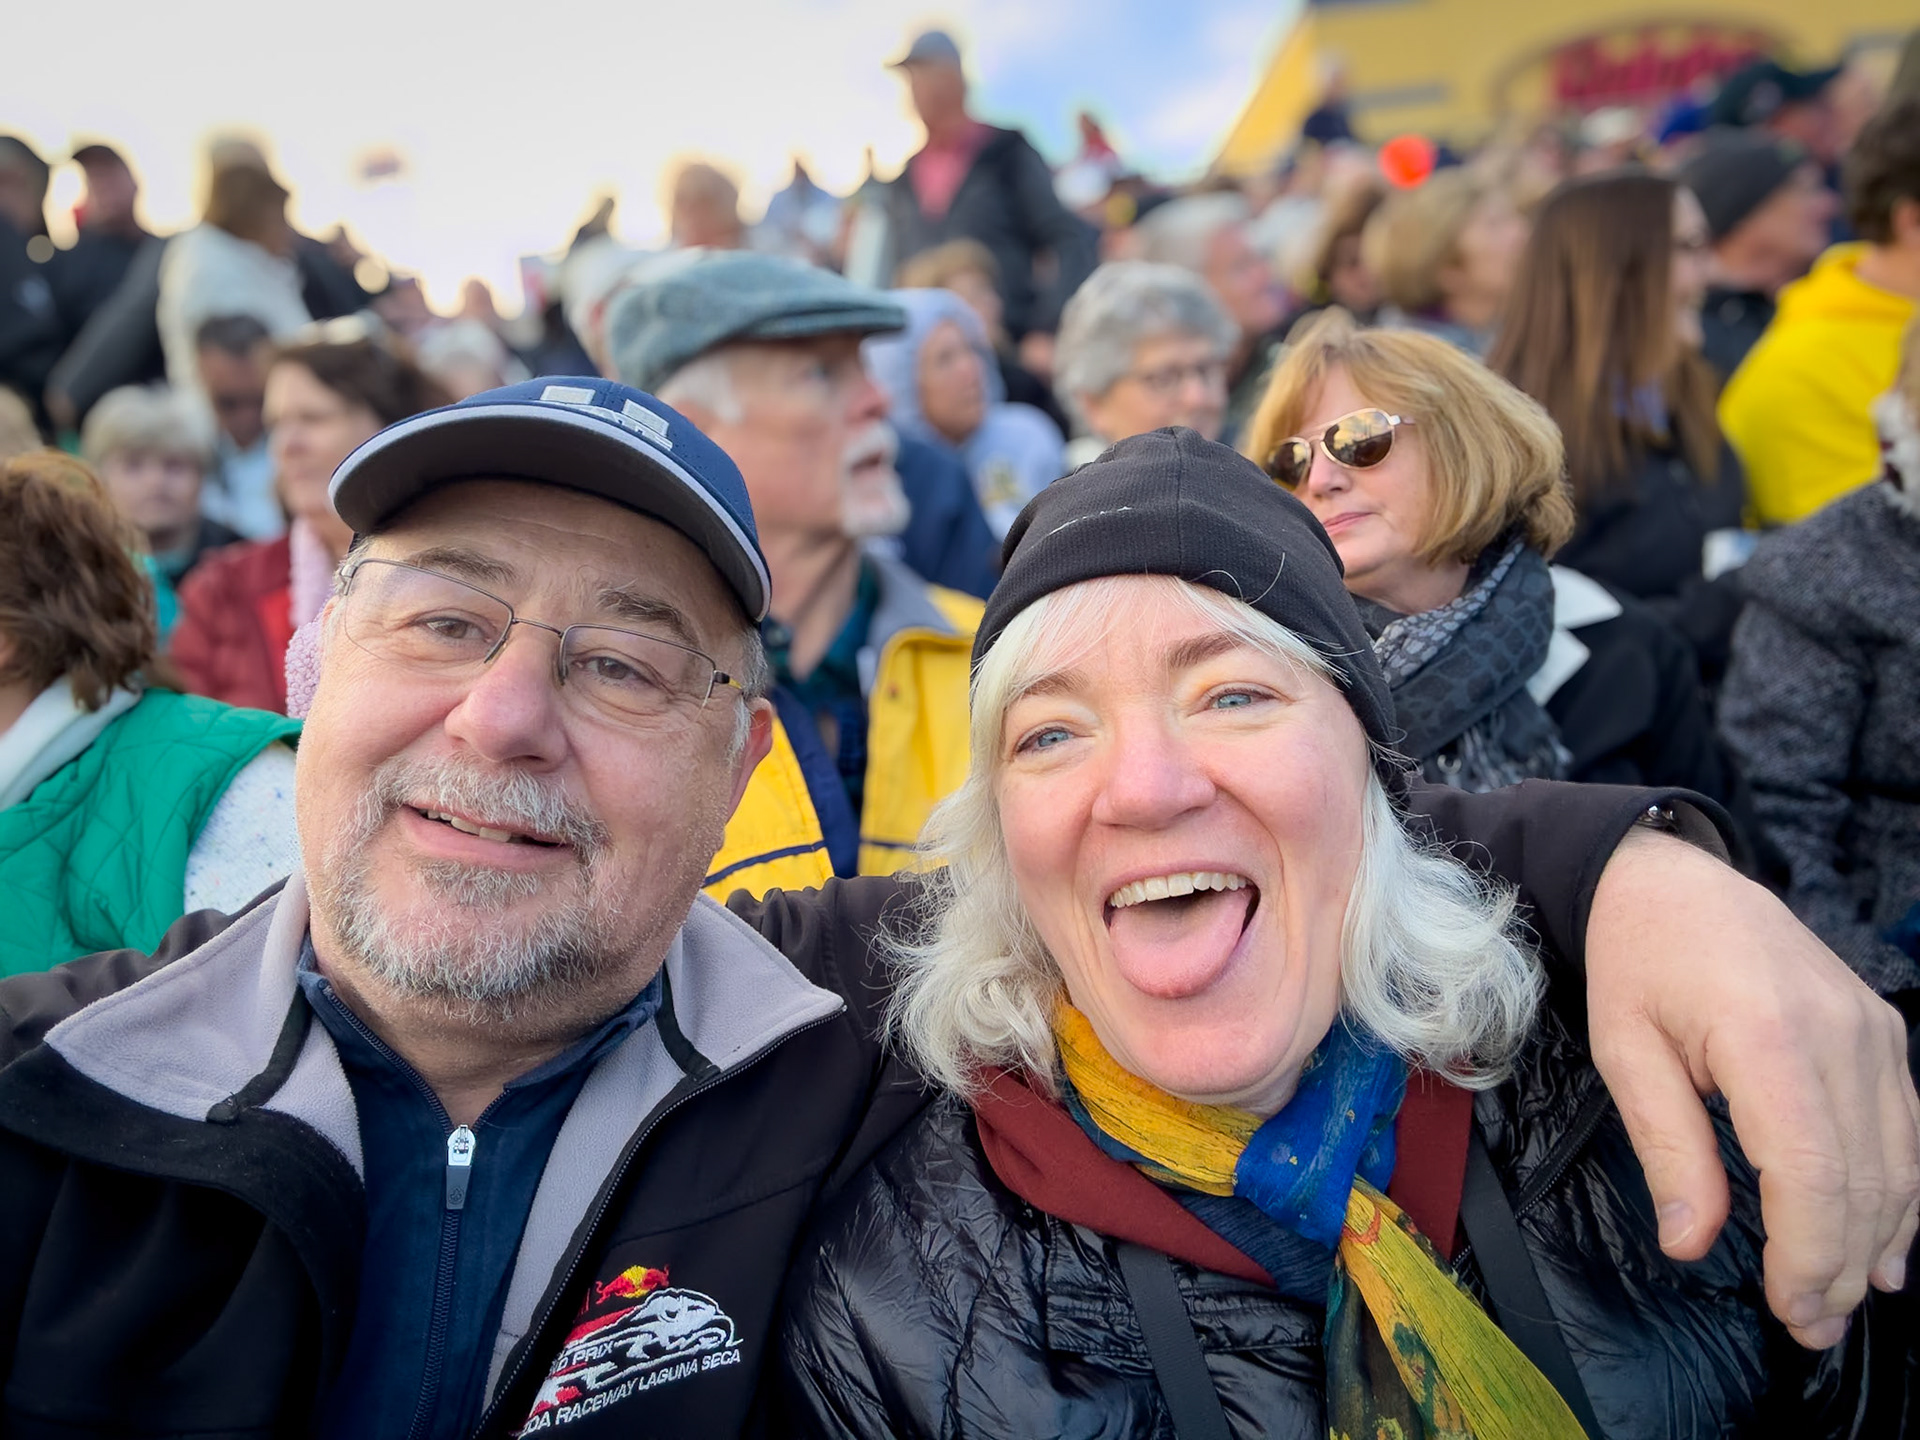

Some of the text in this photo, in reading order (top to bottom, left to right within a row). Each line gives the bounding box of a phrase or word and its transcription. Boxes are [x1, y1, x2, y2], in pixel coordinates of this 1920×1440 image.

[572, 1341, 614, 1366] PRIX
[555, 1378, 639, 1426] RACEWAY
[638, 1358, 699, 1391] LAGUNA
[701, 1348, 741, 1371] SECA
